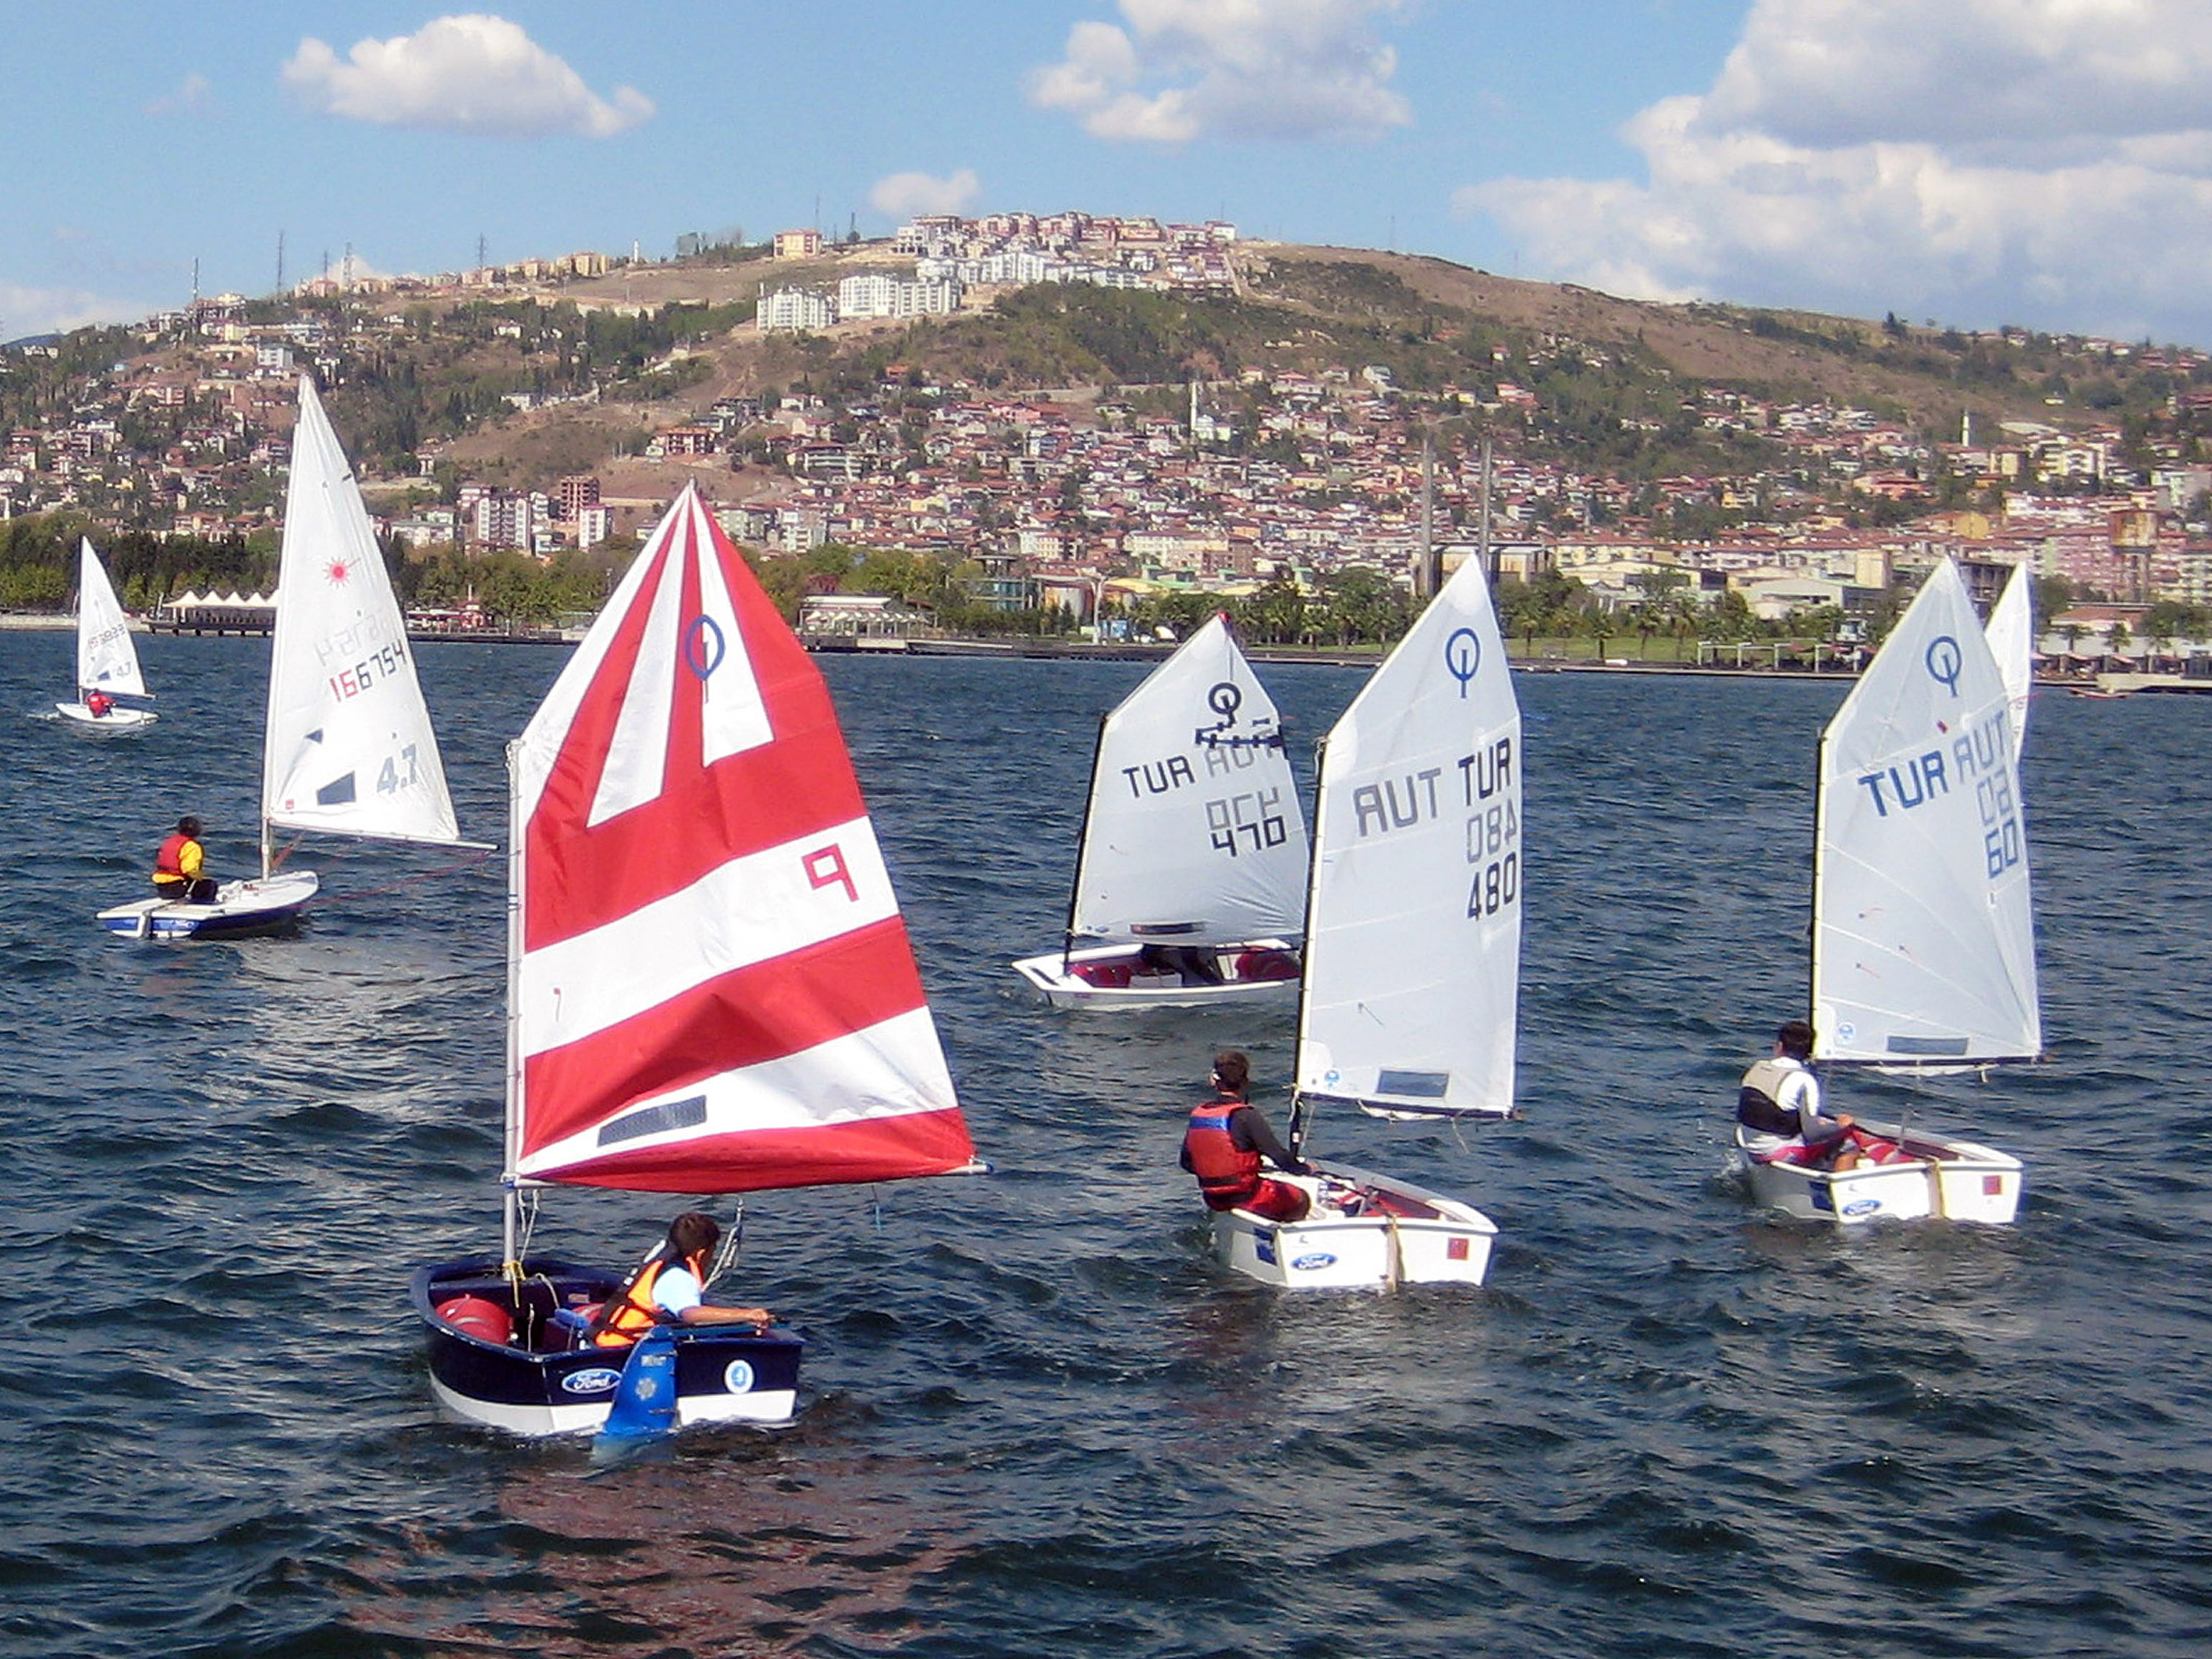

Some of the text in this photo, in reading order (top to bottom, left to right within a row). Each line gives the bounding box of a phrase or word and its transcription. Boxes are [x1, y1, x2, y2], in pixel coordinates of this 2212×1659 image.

[330, 639, 406, 703] 166754
[377, 744, 418, 796] 4.7
[1122, 755, 1195, 799] TUR
[1458, 737, 1511, 806] TUR
[1858, 750, 1948, 817] TUR
[1211, 815, 1286, 857] 470
[1985, 817, 2018, 878] 60
[801, 843, 859, 902] 9
[1467, 851, 1516, 922] 480
[574, 1372, 611, 1390] Ford
